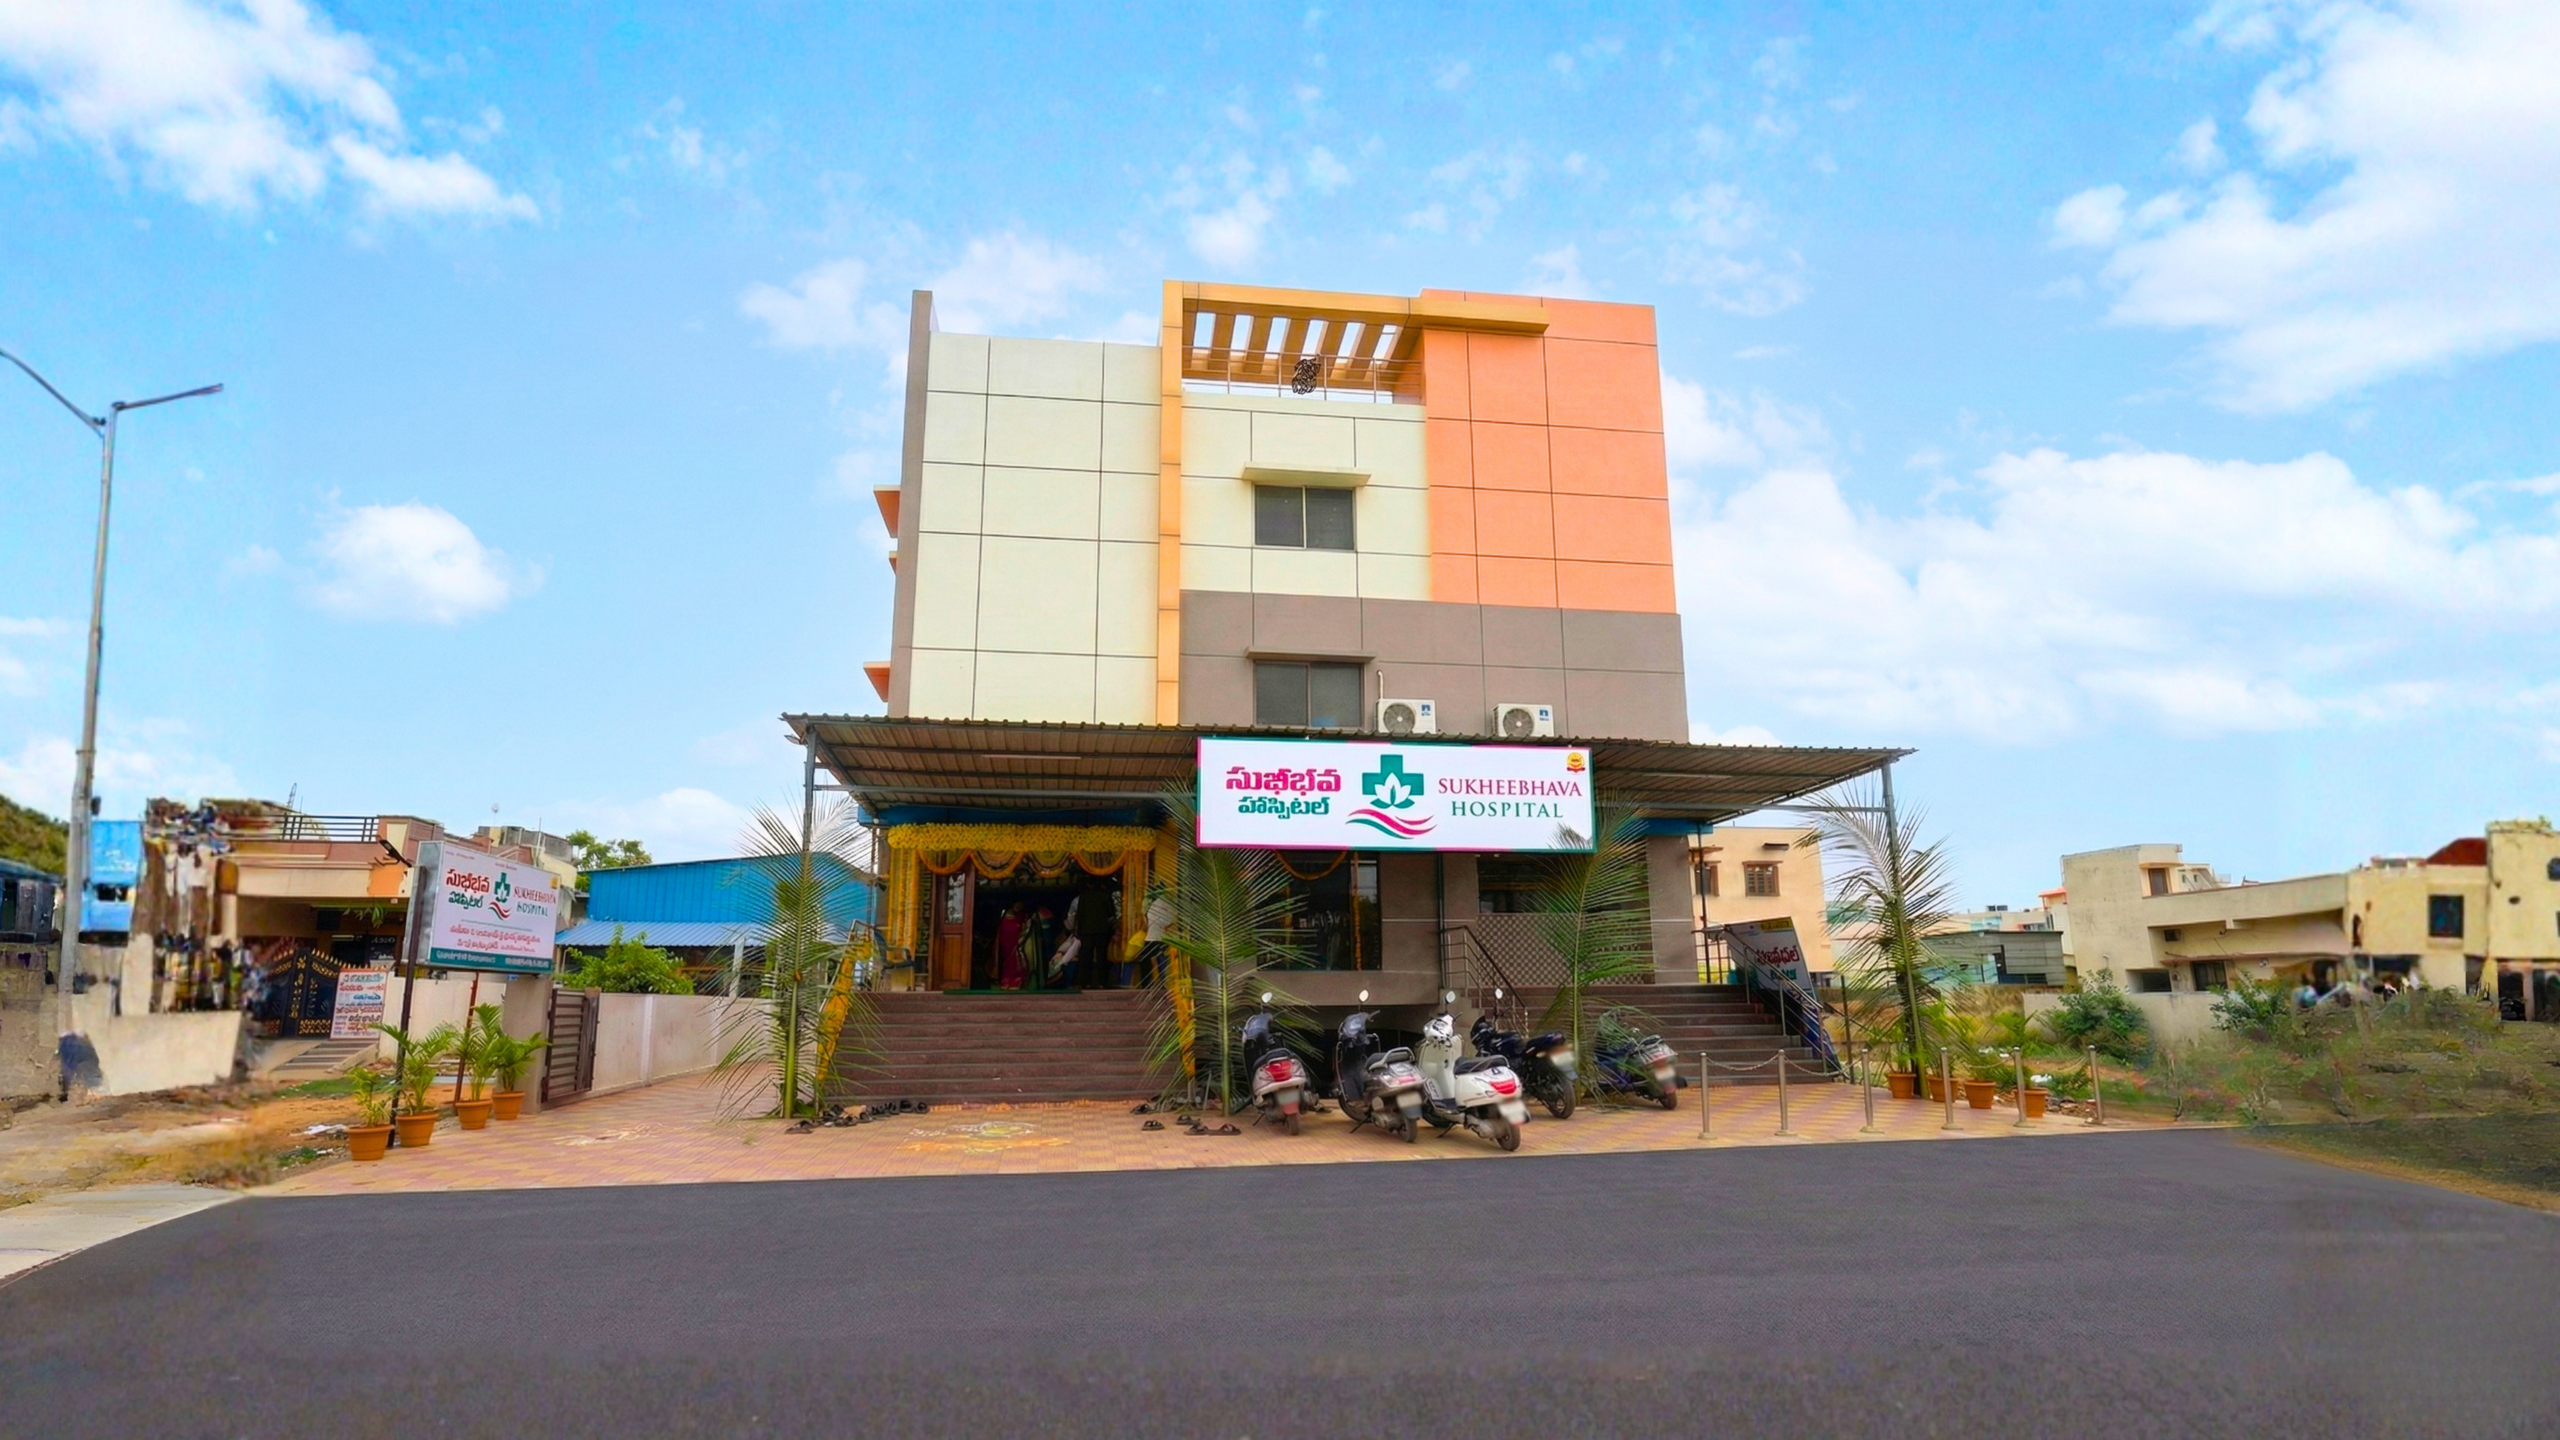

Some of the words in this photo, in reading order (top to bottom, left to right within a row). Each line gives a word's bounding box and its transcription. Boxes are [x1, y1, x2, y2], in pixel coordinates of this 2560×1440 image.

[1226, 766, 1341, 796] సుఖీభవ
[1438, 777, 1583, 797] SUKHEEBHAVA
[1238, 796, 1330, 819] హాస్పిటల్
[1451, 801, 1564, 819] HOSPITAL
[516, 901, 549, 917] HOSPITAL
